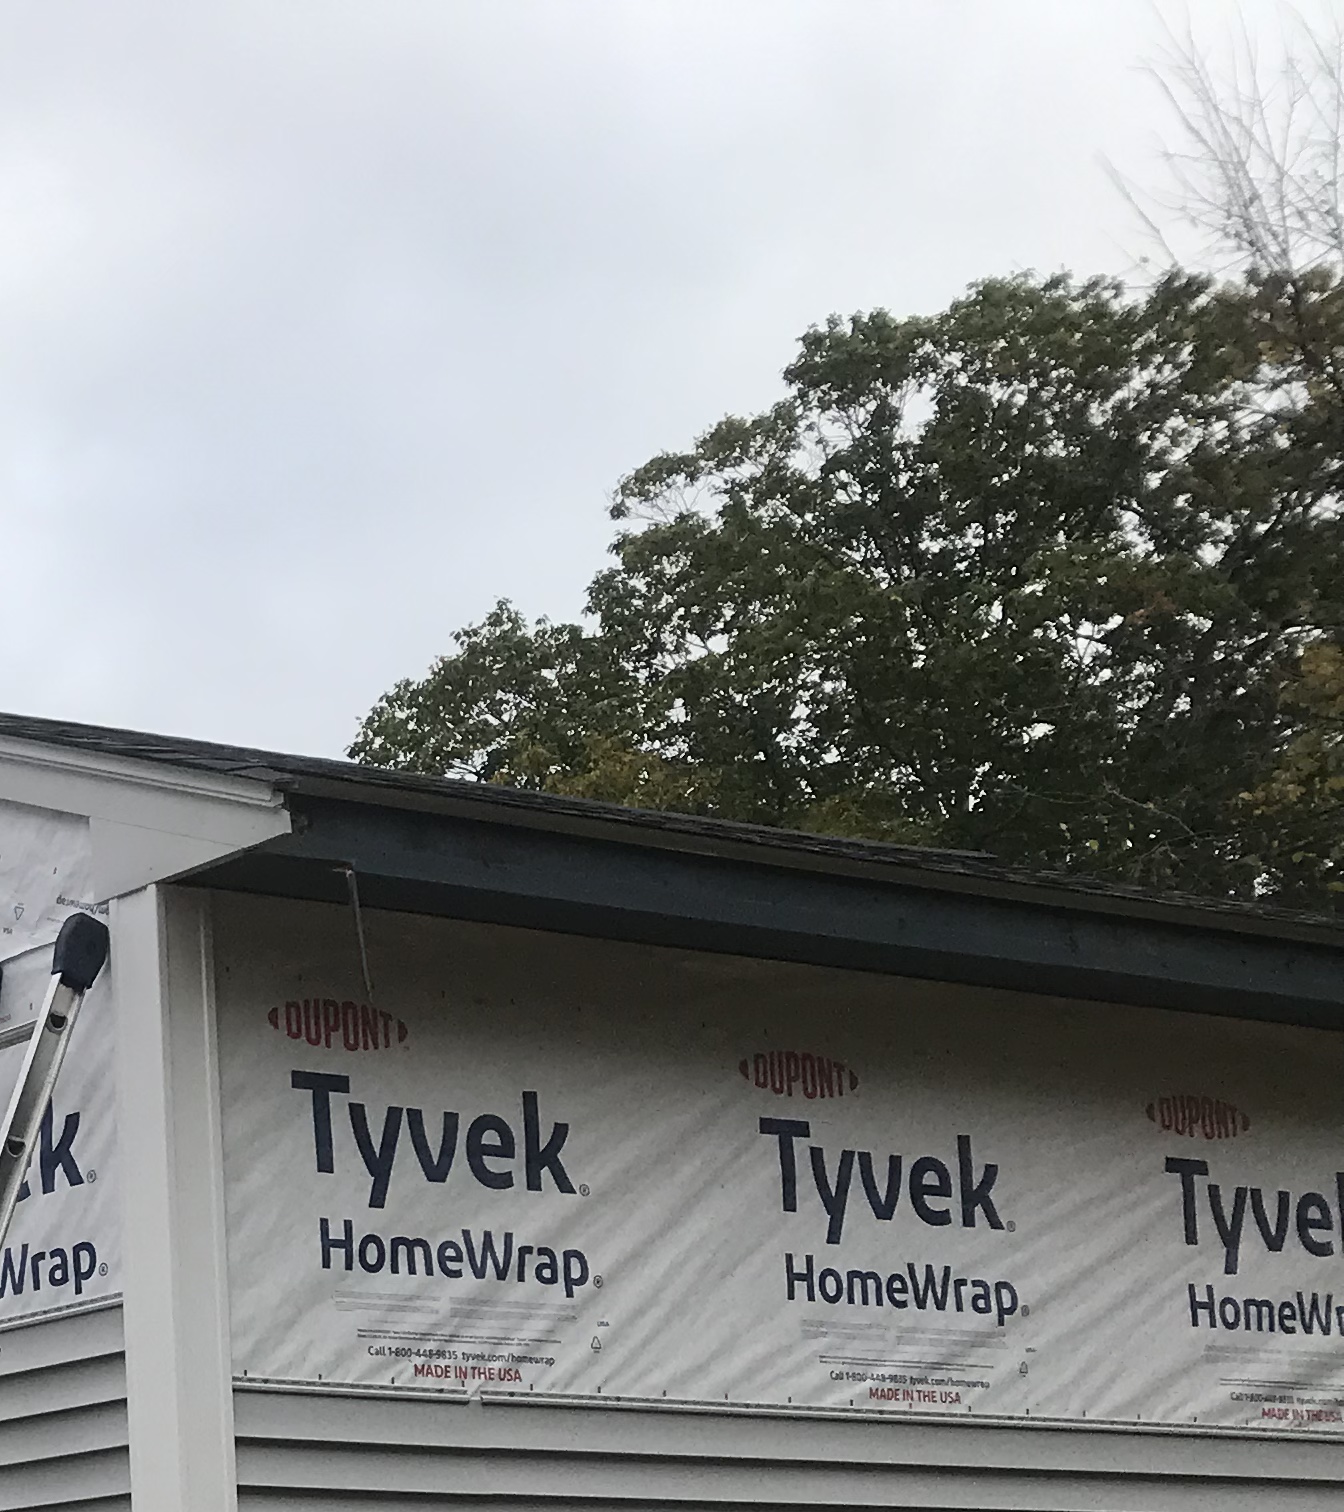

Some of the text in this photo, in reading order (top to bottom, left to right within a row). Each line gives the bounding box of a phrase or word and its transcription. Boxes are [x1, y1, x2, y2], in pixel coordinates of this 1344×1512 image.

[285, 998, 393, 1052] DUPONT
[754, 1050, 847, 1099] DUPONT
[291, 1070, 577, 1209] Tyvek
[759, 1116, 1005, 1245] Tyvek
[319, 1217, 590, 1298] HomeWrap
[785, 1252, 1019, 1327] HomeWrap
[368, 1345, 386, 1357] Call
[414, 1363, 522, 1382] MADE IN THE USA
[869, 1387, 961, 1405] MADE IN THE USA
